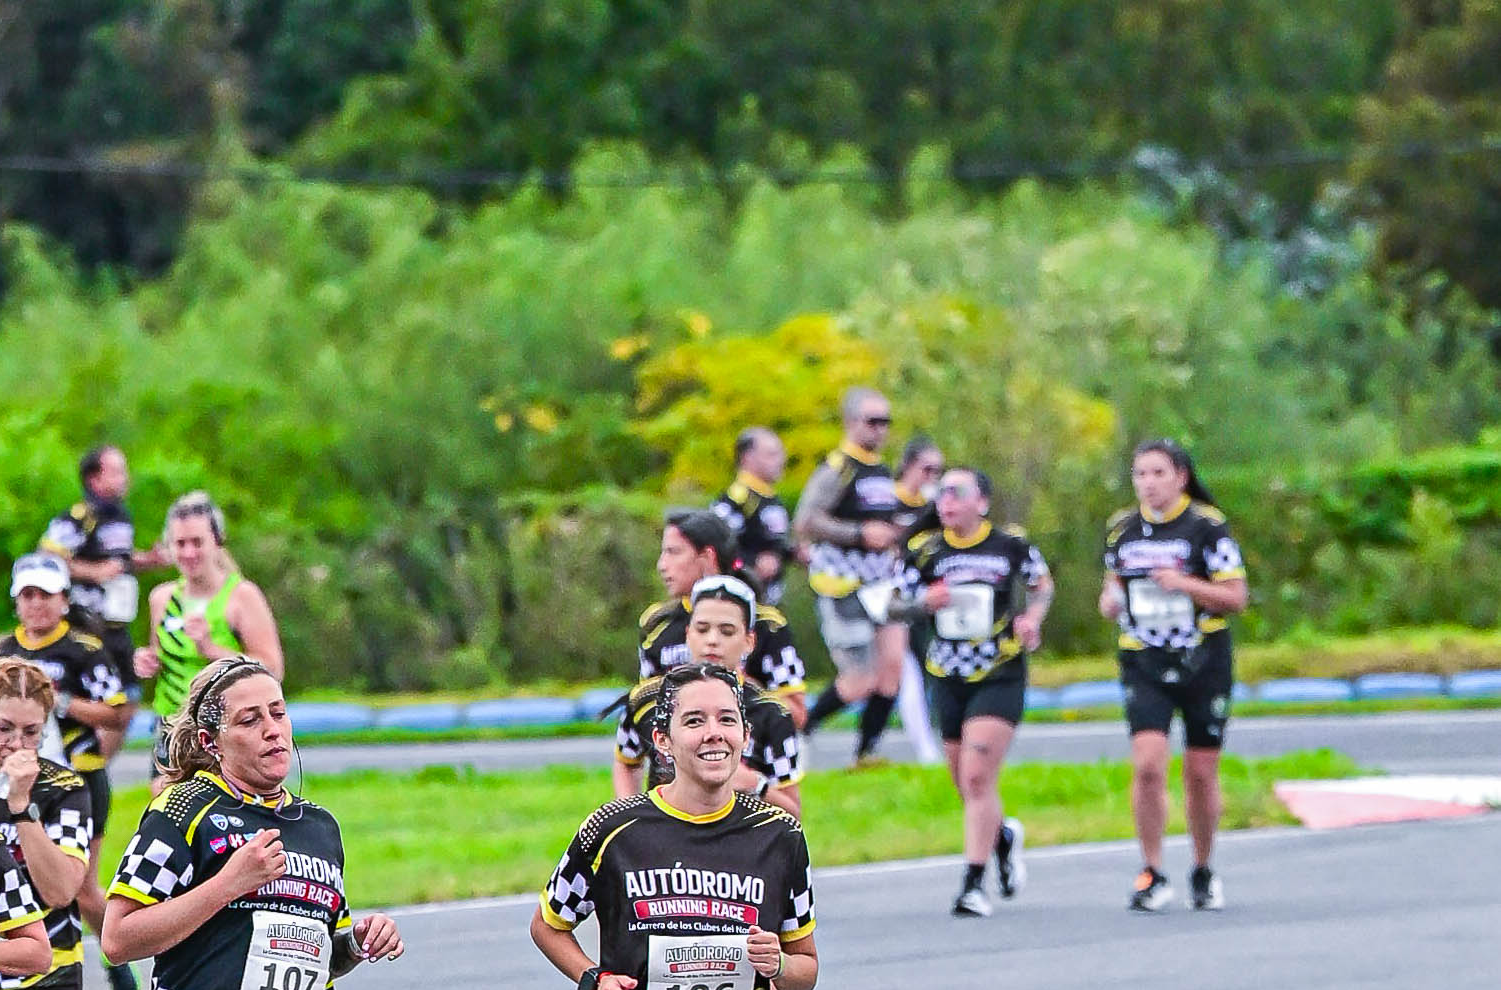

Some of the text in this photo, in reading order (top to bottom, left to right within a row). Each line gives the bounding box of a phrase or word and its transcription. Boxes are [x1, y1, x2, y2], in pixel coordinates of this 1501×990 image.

[624, 861, 765, 905] AUTÓDROMO
[239, 901, 269, 909] Carrera
[269, 902, 279, 910] de
[308, 883, 335, 908] RACE
[648, 899, 745, 922] RUNNING RACE
[628, 922, 637, 931] La
[636, 921, 666, 931] Carrera
[667, 921, 679, 930] de
[680, 920, 692, 930] los
[693, 922, 721, 932] Clubes
[722, 924, 735, 933] del
[665, 943, 743, 963] AUTÓDROMO
